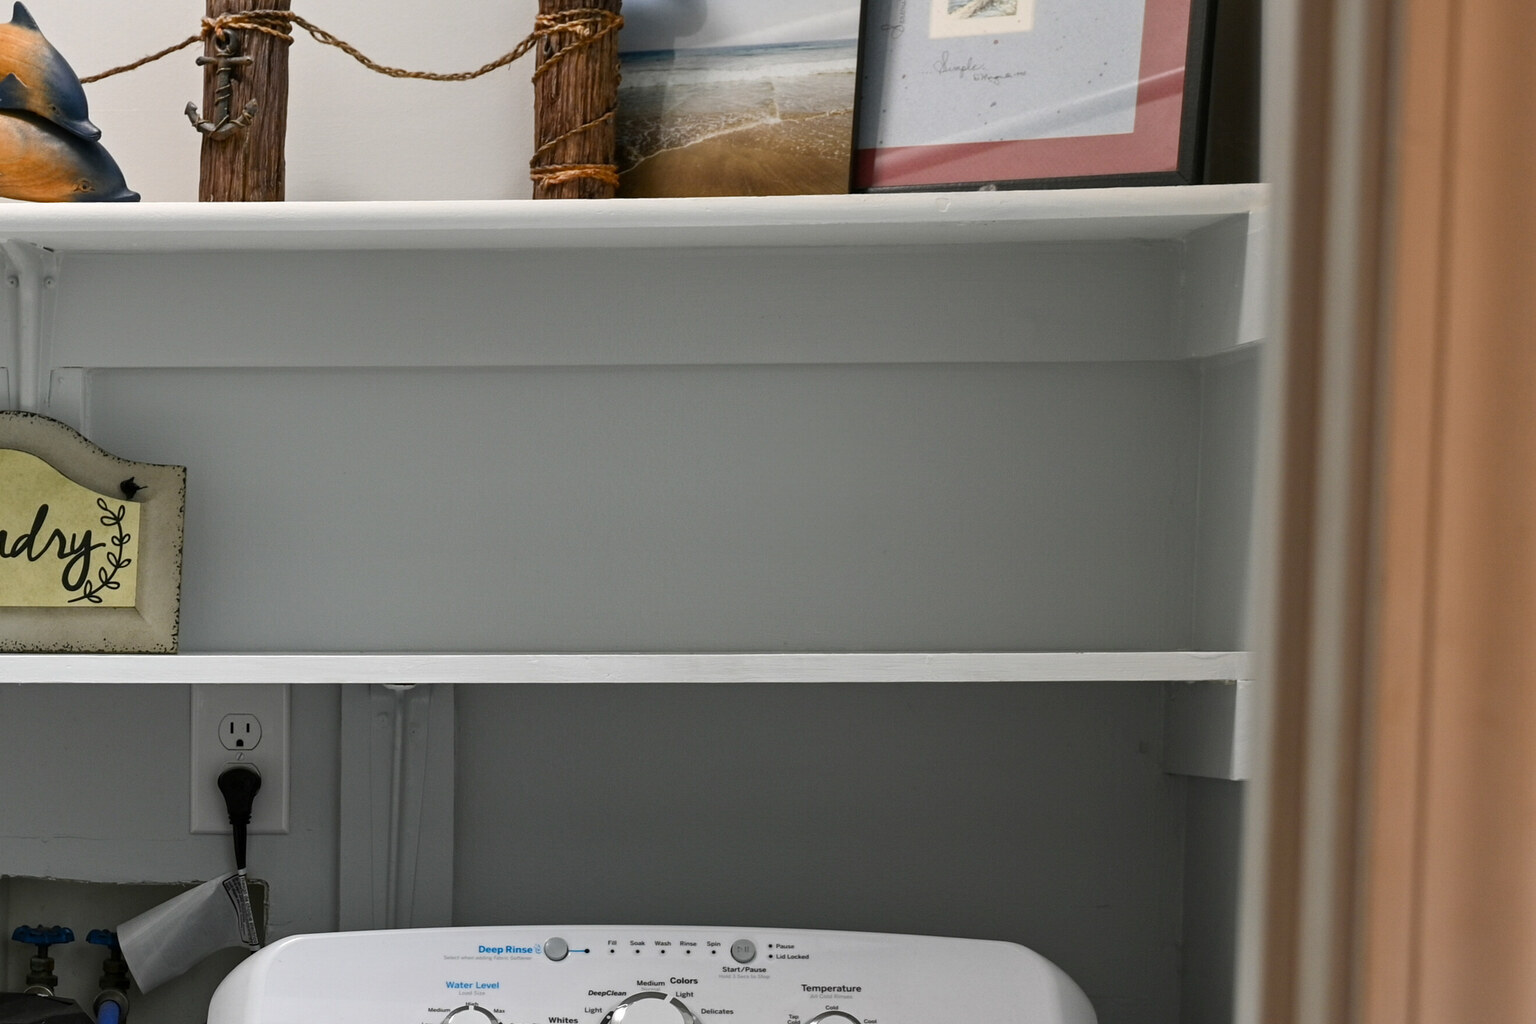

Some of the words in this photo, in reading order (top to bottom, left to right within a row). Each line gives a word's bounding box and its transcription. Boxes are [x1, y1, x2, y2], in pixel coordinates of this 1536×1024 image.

[478, 945, 504, 955] Deep
[505, 945, 533, 954] Rinse
[722, 966, 767, 974] Start/Pause
[445, 981, 474, 989] Water
[475, 981, 500, 989] Level
[669, 977, 699, 985] Colors
[801, 983, 862, 993] Temperature
[587, 989, 627, 998] DeepClean
[584, 1007, 603, 1015] Light
[548, 1016, 579, 1024] Whites
